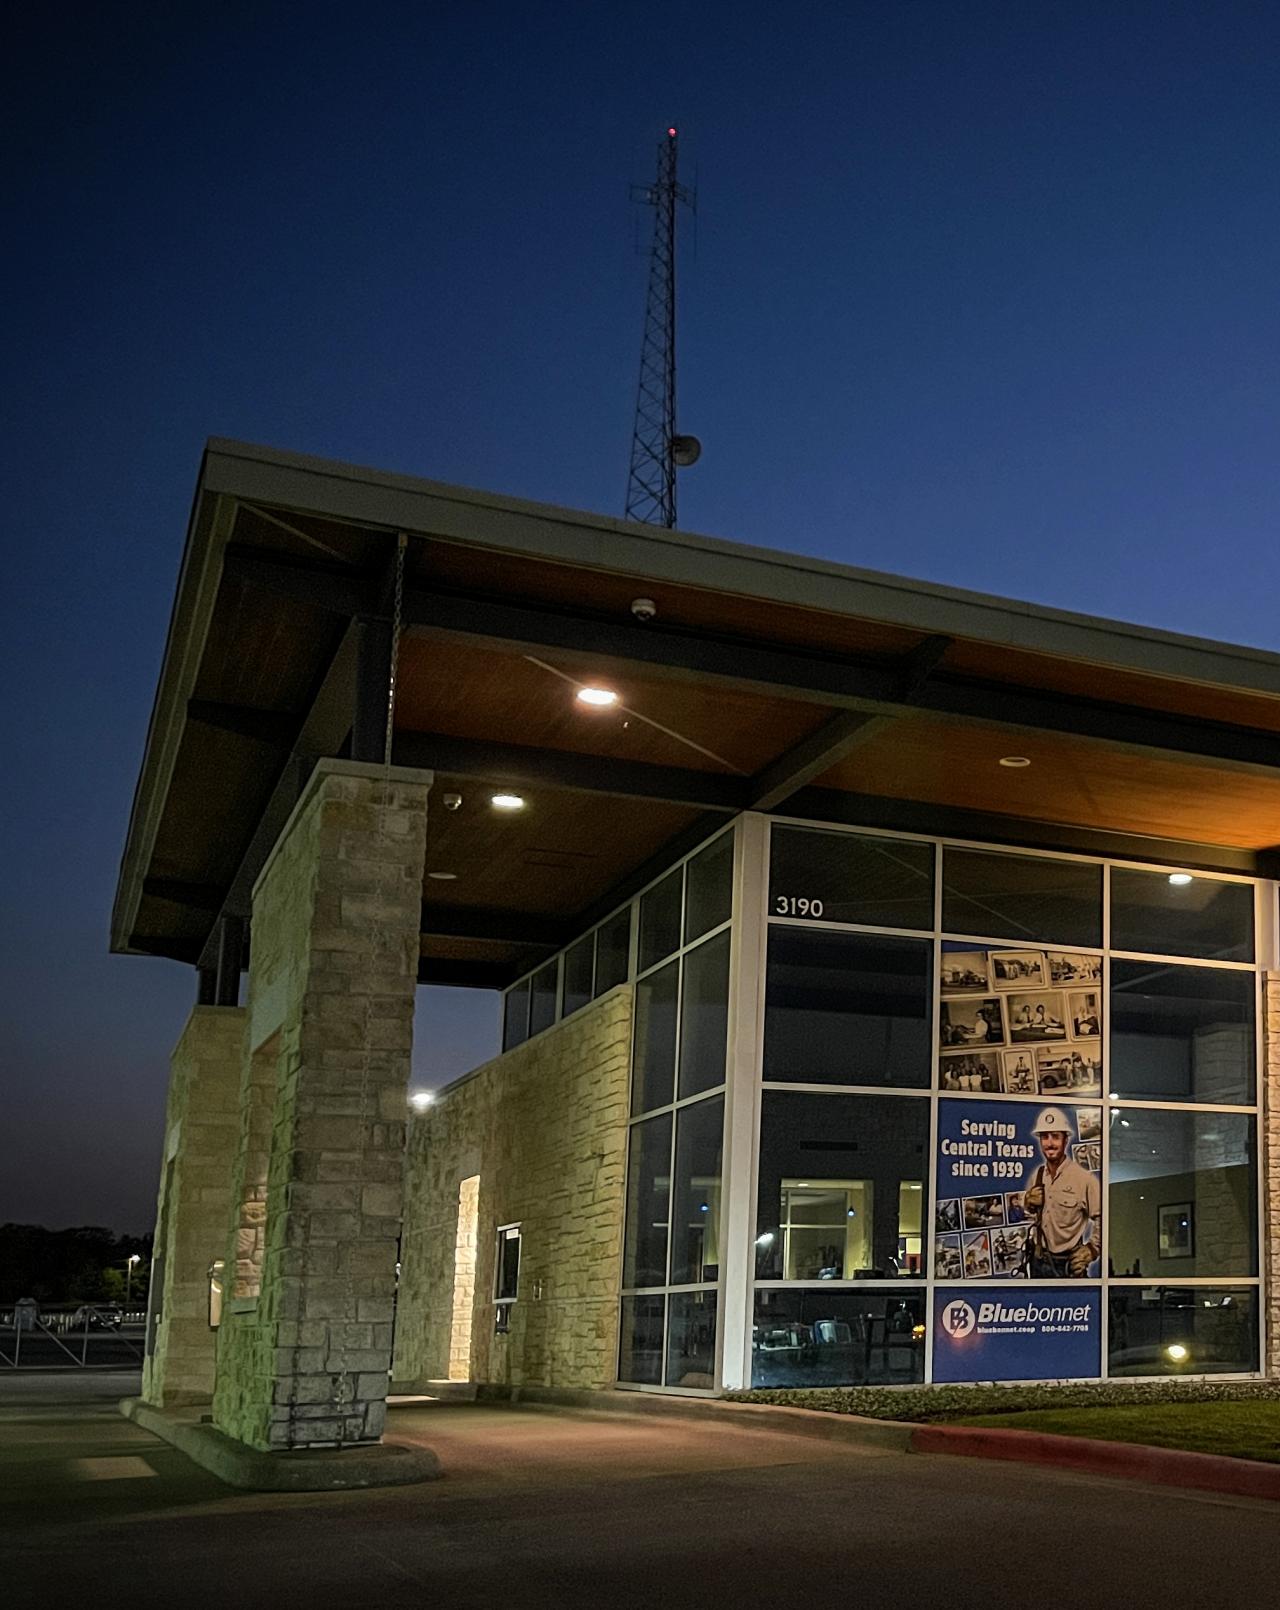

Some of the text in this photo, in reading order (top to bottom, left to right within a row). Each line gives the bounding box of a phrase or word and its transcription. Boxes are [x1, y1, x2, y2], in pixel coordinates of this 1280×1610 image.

[776, 896, 823, 917] 3190
[961, 1119, 1016, 1140] Serving
[941, 1139, 1034, 1158] Central Texas
[951, 1160, 1023, 1178] since 1939
[977, 1303, 1091, 1323] Bluebonnet
